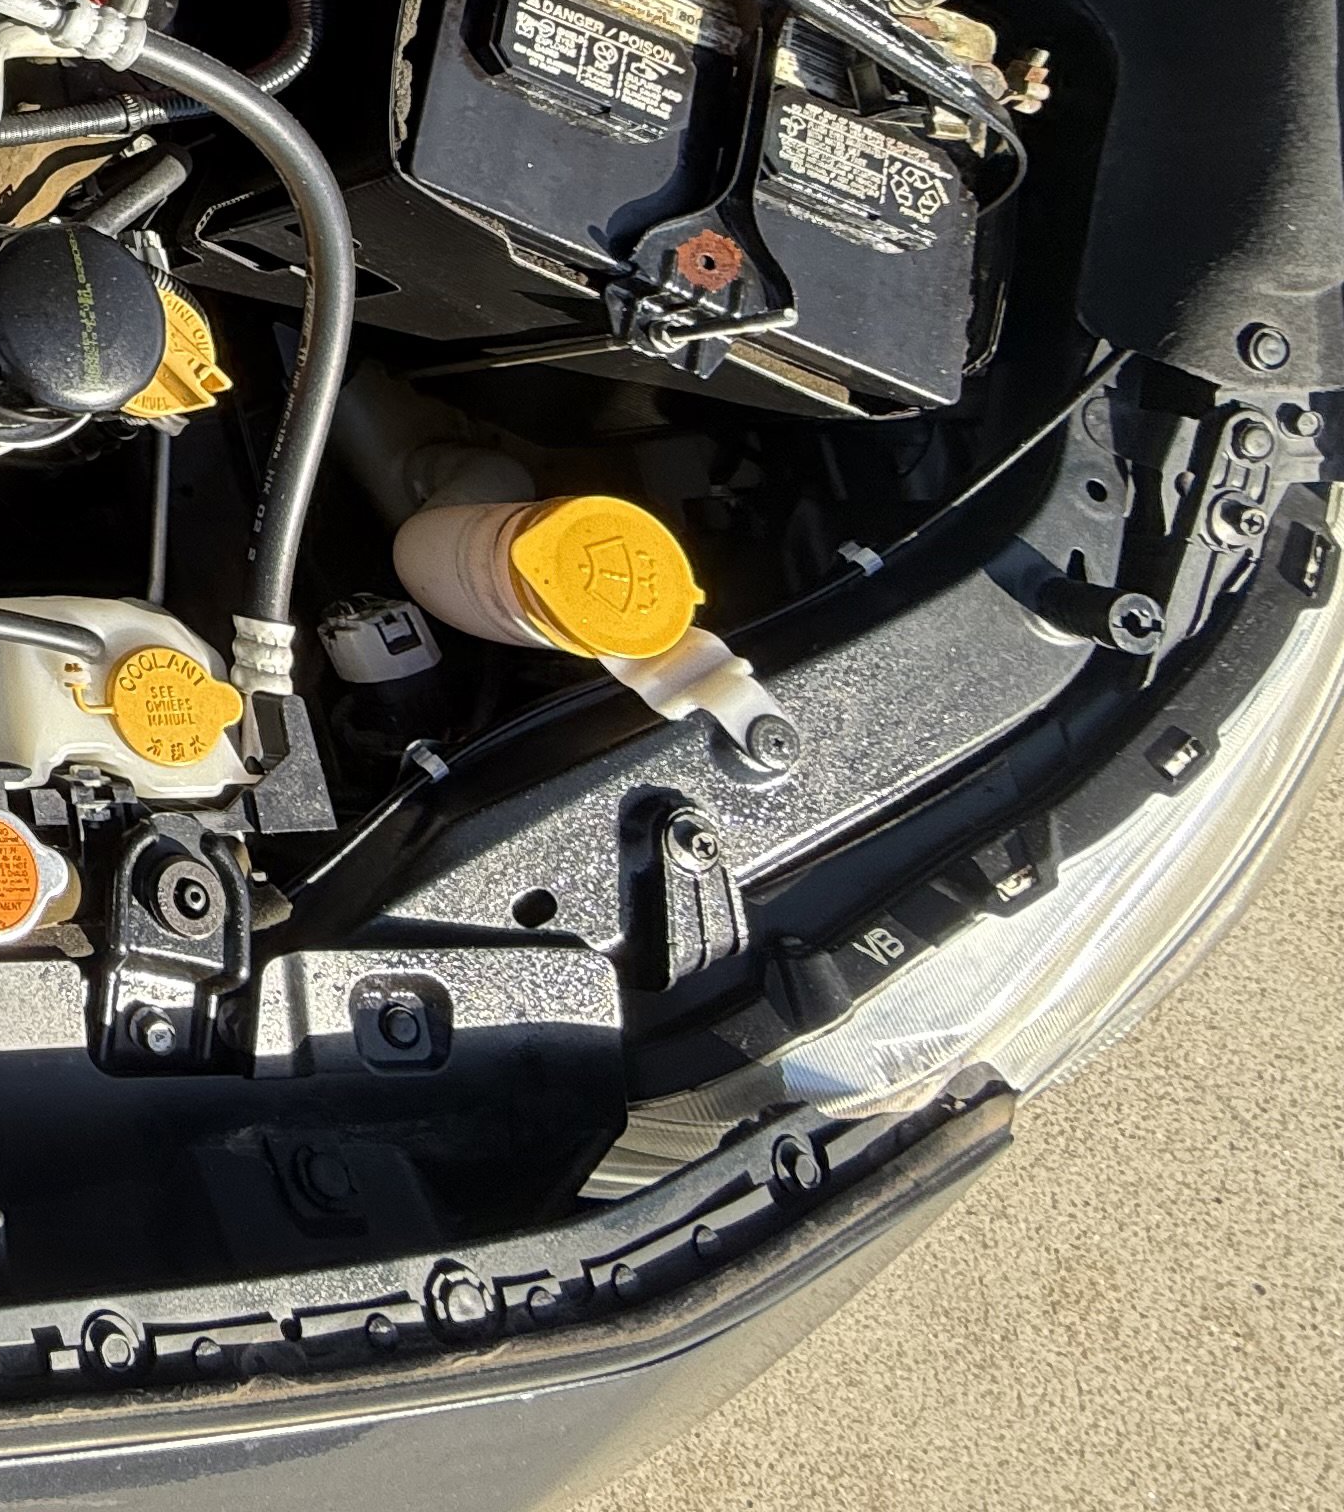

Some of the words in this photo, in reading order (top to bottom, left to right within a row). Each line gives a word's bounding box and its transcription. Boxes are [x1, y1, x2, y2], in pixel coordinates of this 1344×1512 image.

[619, 31, 676, 64] POISON
[118, 652, 206, 692] COOLANT
[150, 685, 175, 700] SEE
[147, 712, 196, 727] MANUAL
[851, 928, 905, 966] VB
